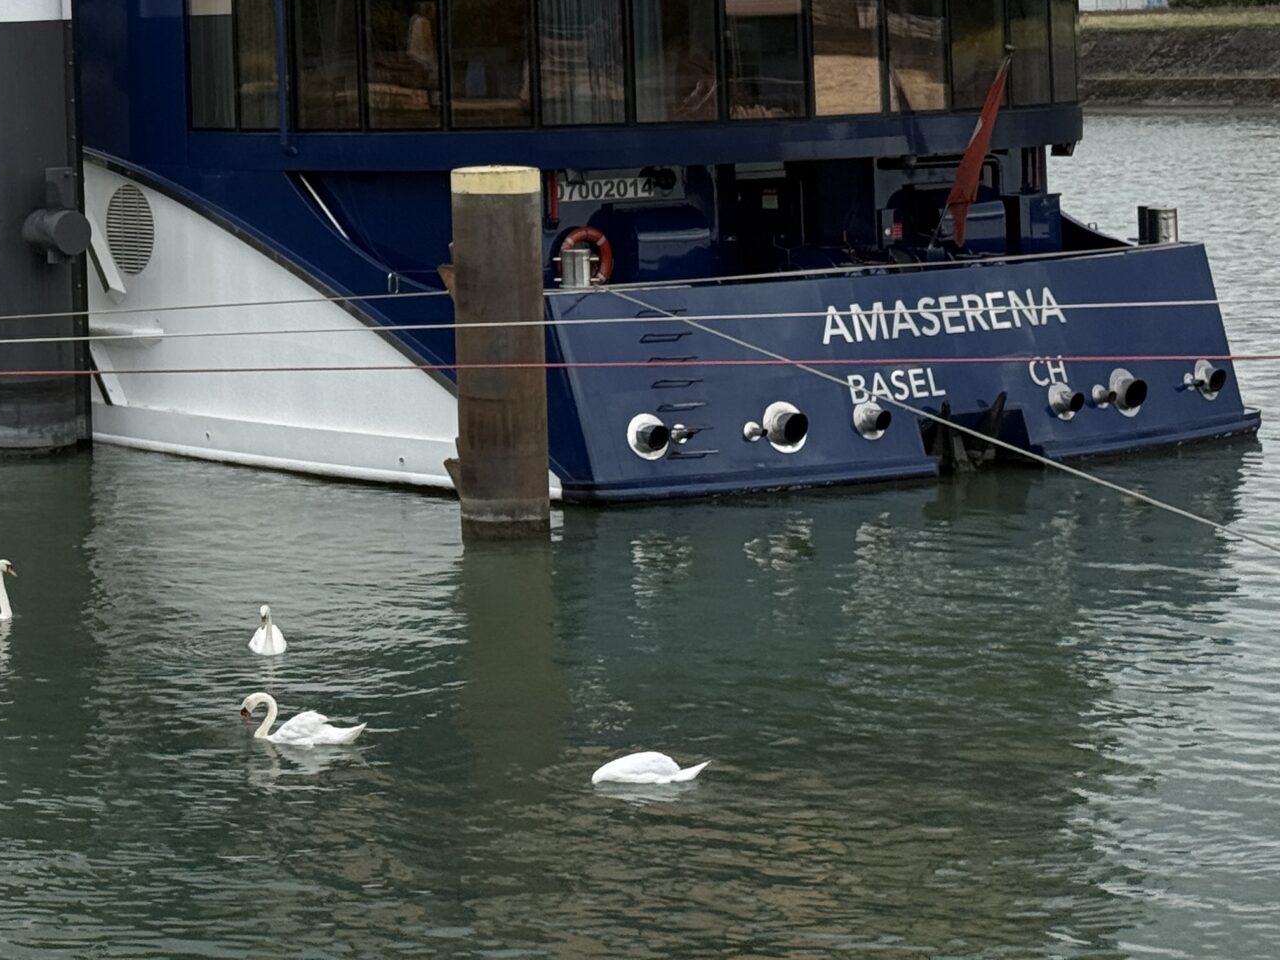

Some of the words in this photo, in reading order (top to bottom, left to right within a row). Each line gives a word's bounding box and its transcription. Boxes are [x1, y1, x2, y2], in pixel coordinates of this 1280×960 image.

[822, 286, 1067, 345] AMASERENA
[847, 367, 947, 405] BASEL
[1028, 355, 1069, 387] CH
